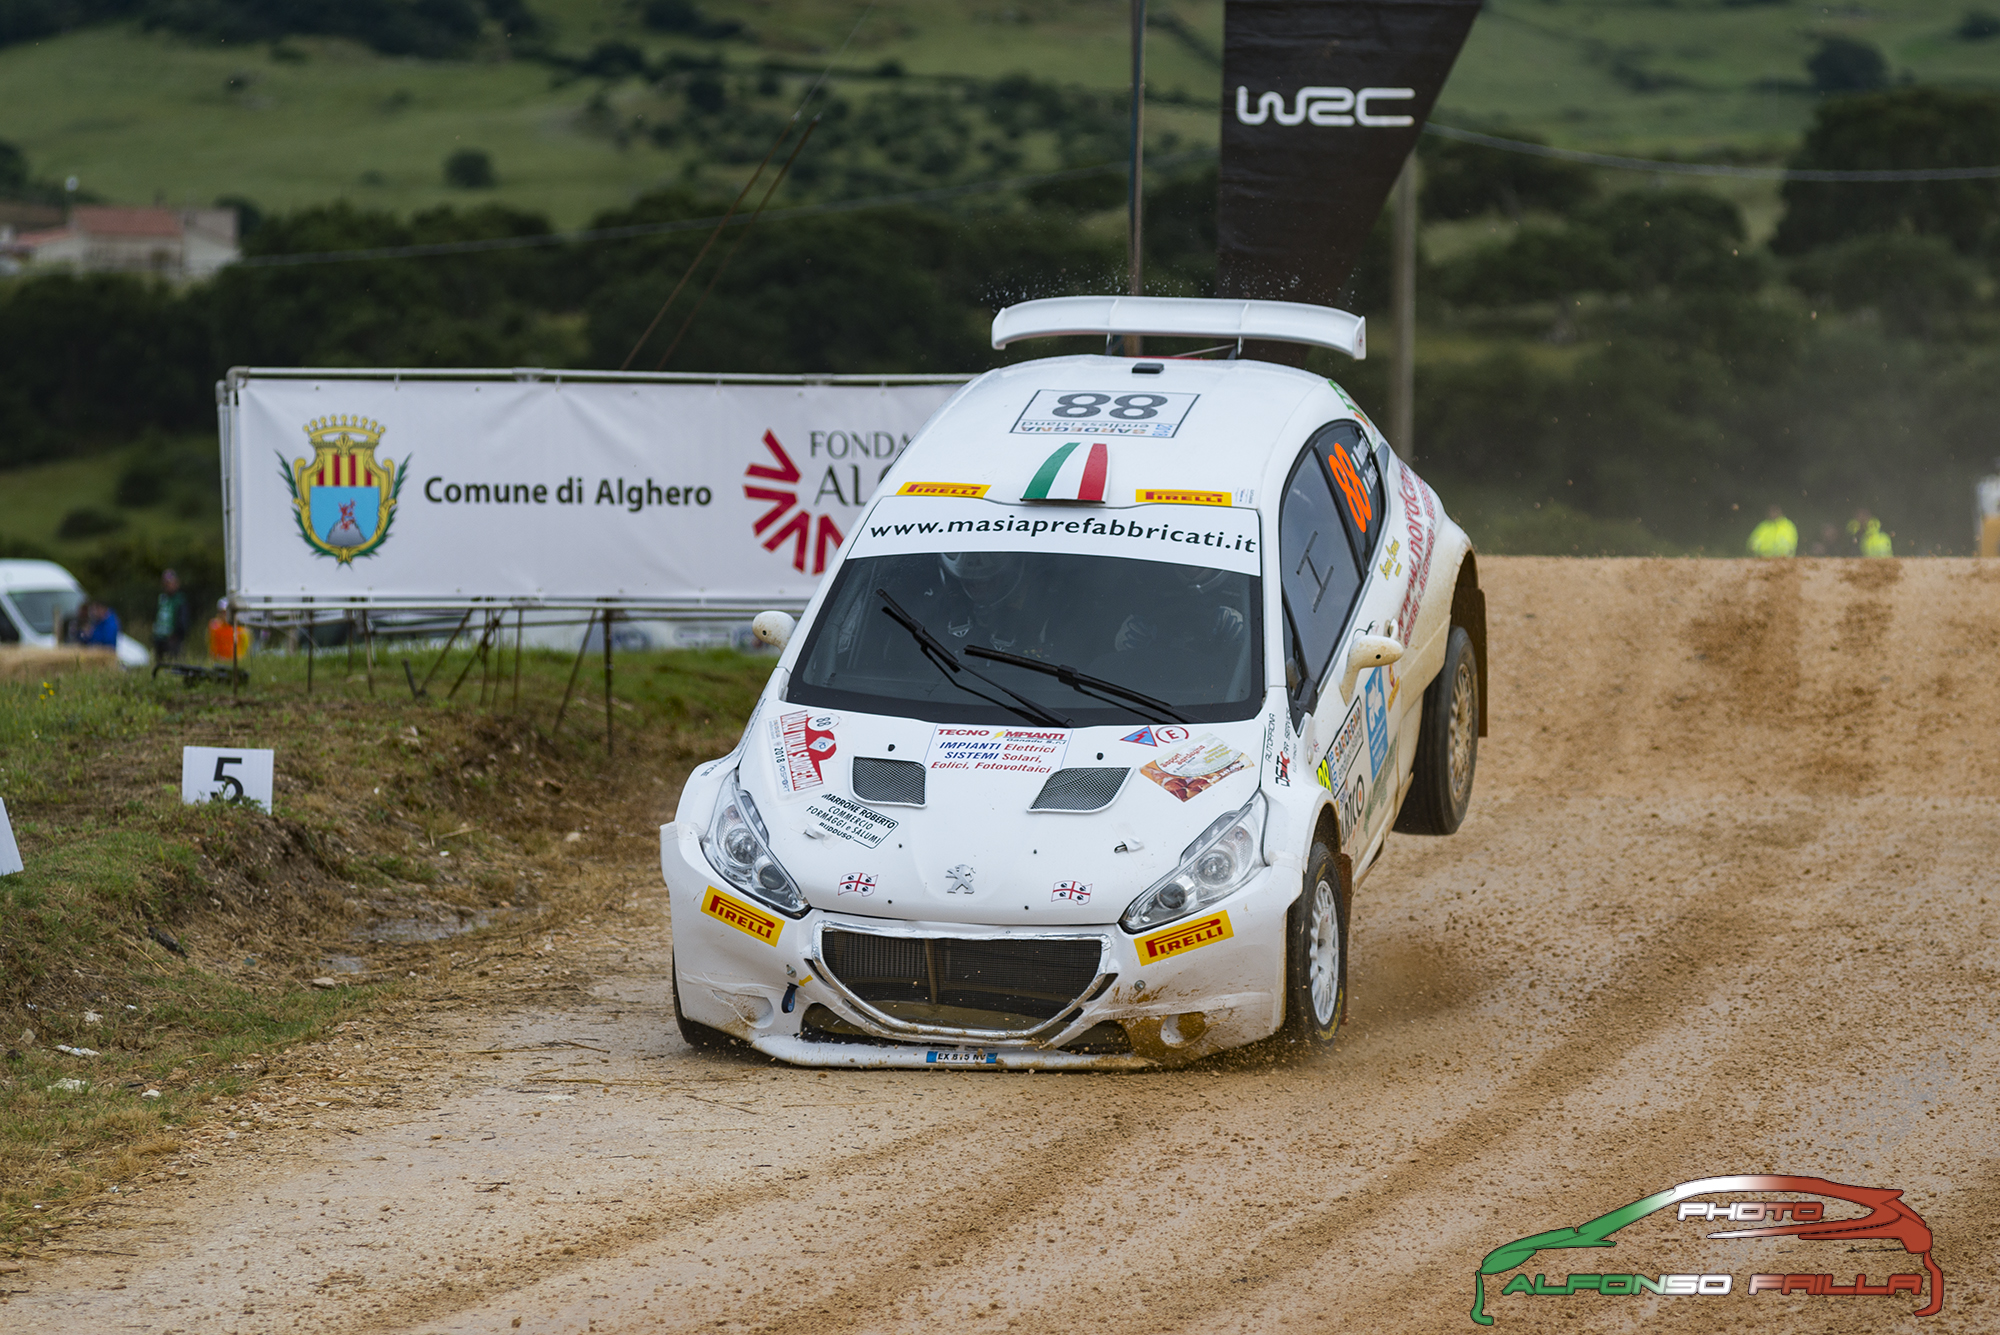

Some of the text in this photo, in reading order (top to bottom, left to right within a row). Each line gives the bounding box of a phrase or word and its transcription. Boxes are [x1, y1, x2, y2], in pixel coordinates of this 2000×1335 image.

[1236, 85, 1415, 127] WRC
[1052, 392, 1168, 420] 88
[1020, 425, 1146, 434] SARDEGNA
[424, 477, 712, 513] Comune di Alghero
[906, 483, 982, 496] PIRELLI
[1145, 491, 1223, 503] PIRELLI
[1328, 442, 1372, 533] 88
[870, 514, 1256, 553] www.masiaprefabbricati.it
[815, 715, 831, 727] 88
[938, 728, 990, 737] TECNO
[1165, 729, 1179, 740] E
[773, 746, 786, 763] 2018
[939, 741, 1057, 754] IMPIANTI Elettrici
[944, 751, 1043, 763] SISTEMI Solari,
[930, 761, 1053, 774] Eolici, Fotovoltaici
[210, 757, 244, 803] 5
[806, 805, 848, 828] FORMAGGI
[850, 826, 881, 844] SALUMI
[827, 805, 874, 831] COMMERCIO
[859, 809, 896, 829] ROBERTO
[709, 894, 776, 939] PIRELLI
[1145, 918, 1223, 958] PIRELLI
